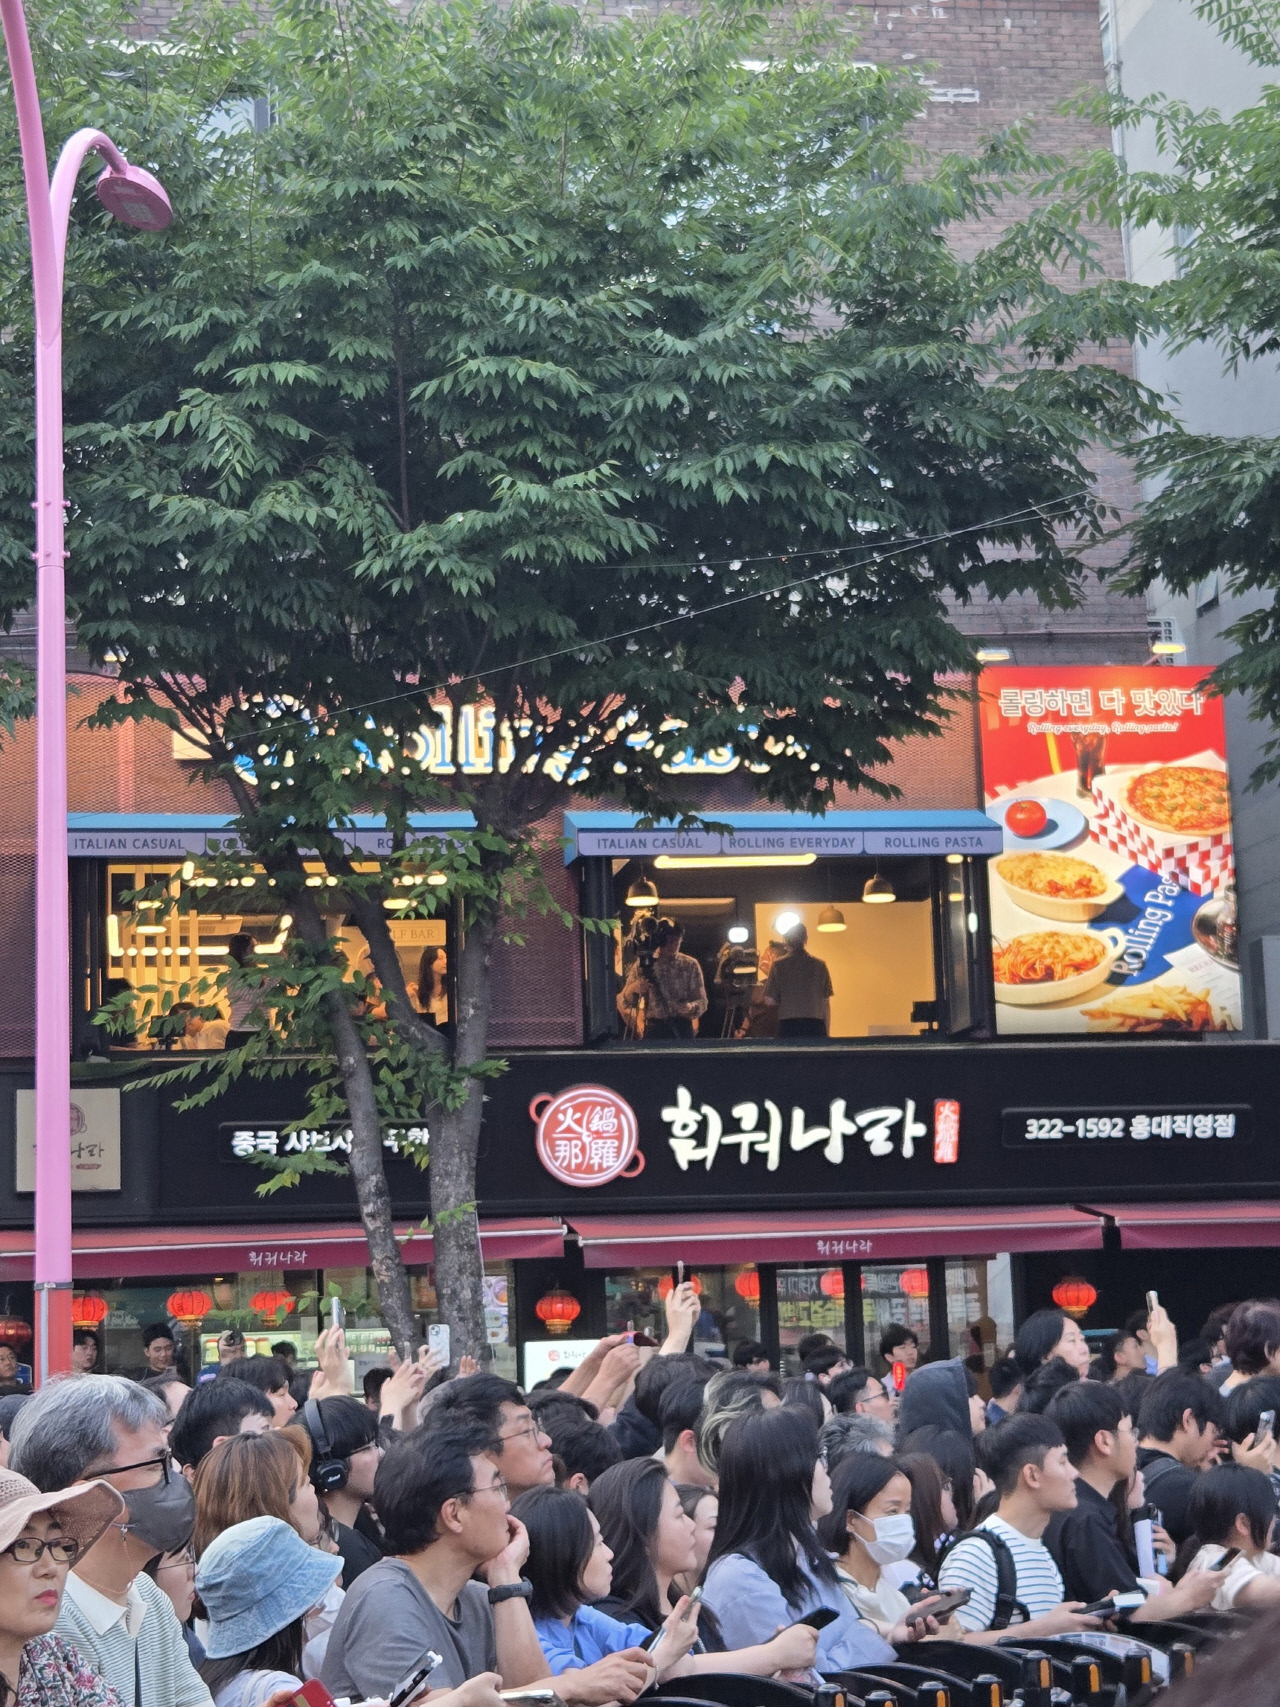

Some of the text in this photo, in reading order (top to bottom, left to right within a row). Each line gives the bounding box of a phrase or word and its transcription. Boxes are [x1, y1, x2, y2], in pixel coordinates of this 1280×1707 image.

[999, 687, 1204, 717] 롤링하면 다 맛있다
[1027, 721, 1063, 736] Rolling
[1111, 721, 1146, 735] Rolling
[1144, 722, 1179, 735] pasta!
[74, 838, 185, 850] ITALIAN CASUAL
[597, 838, 703, 849] ITALIAN CASUAL
[729, 837, 856, 849] ROLLING EVERYDAY
[884, 836, 983, 848] ROLLING PASTA
[411, 929, 435, 939] BAR
[1110, 906, 1173, 977] Rolling
[661, 1084, 927, 1171] 훠궈나라
[1025, 1114, 1236, 1140] 322-1592 홍대직영점
[231, 1130, 279, 1156] 중국
